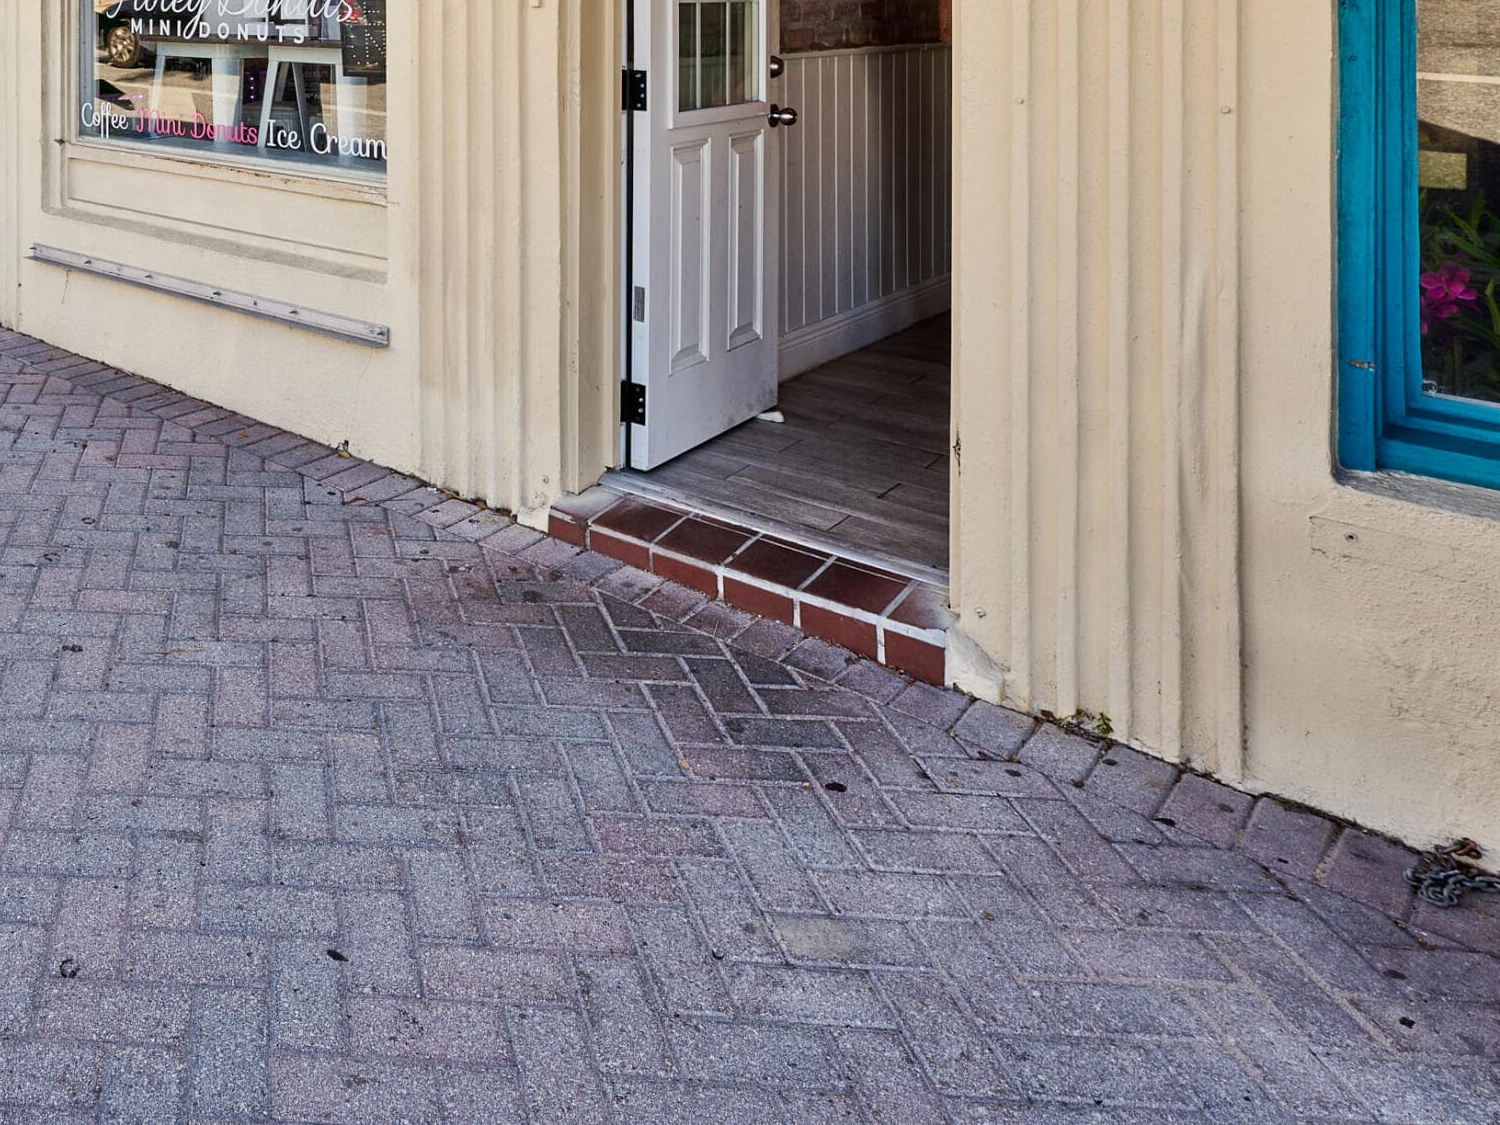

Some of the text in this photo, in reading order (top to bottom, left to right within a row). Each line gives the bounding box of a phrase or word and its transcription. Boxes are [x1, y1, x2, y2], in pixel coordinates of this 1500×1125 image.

[130, 17, 305, 44] MINI DONUTS
[81, 102, 387, 160] Coffee Mini Donuts Ice Cream
